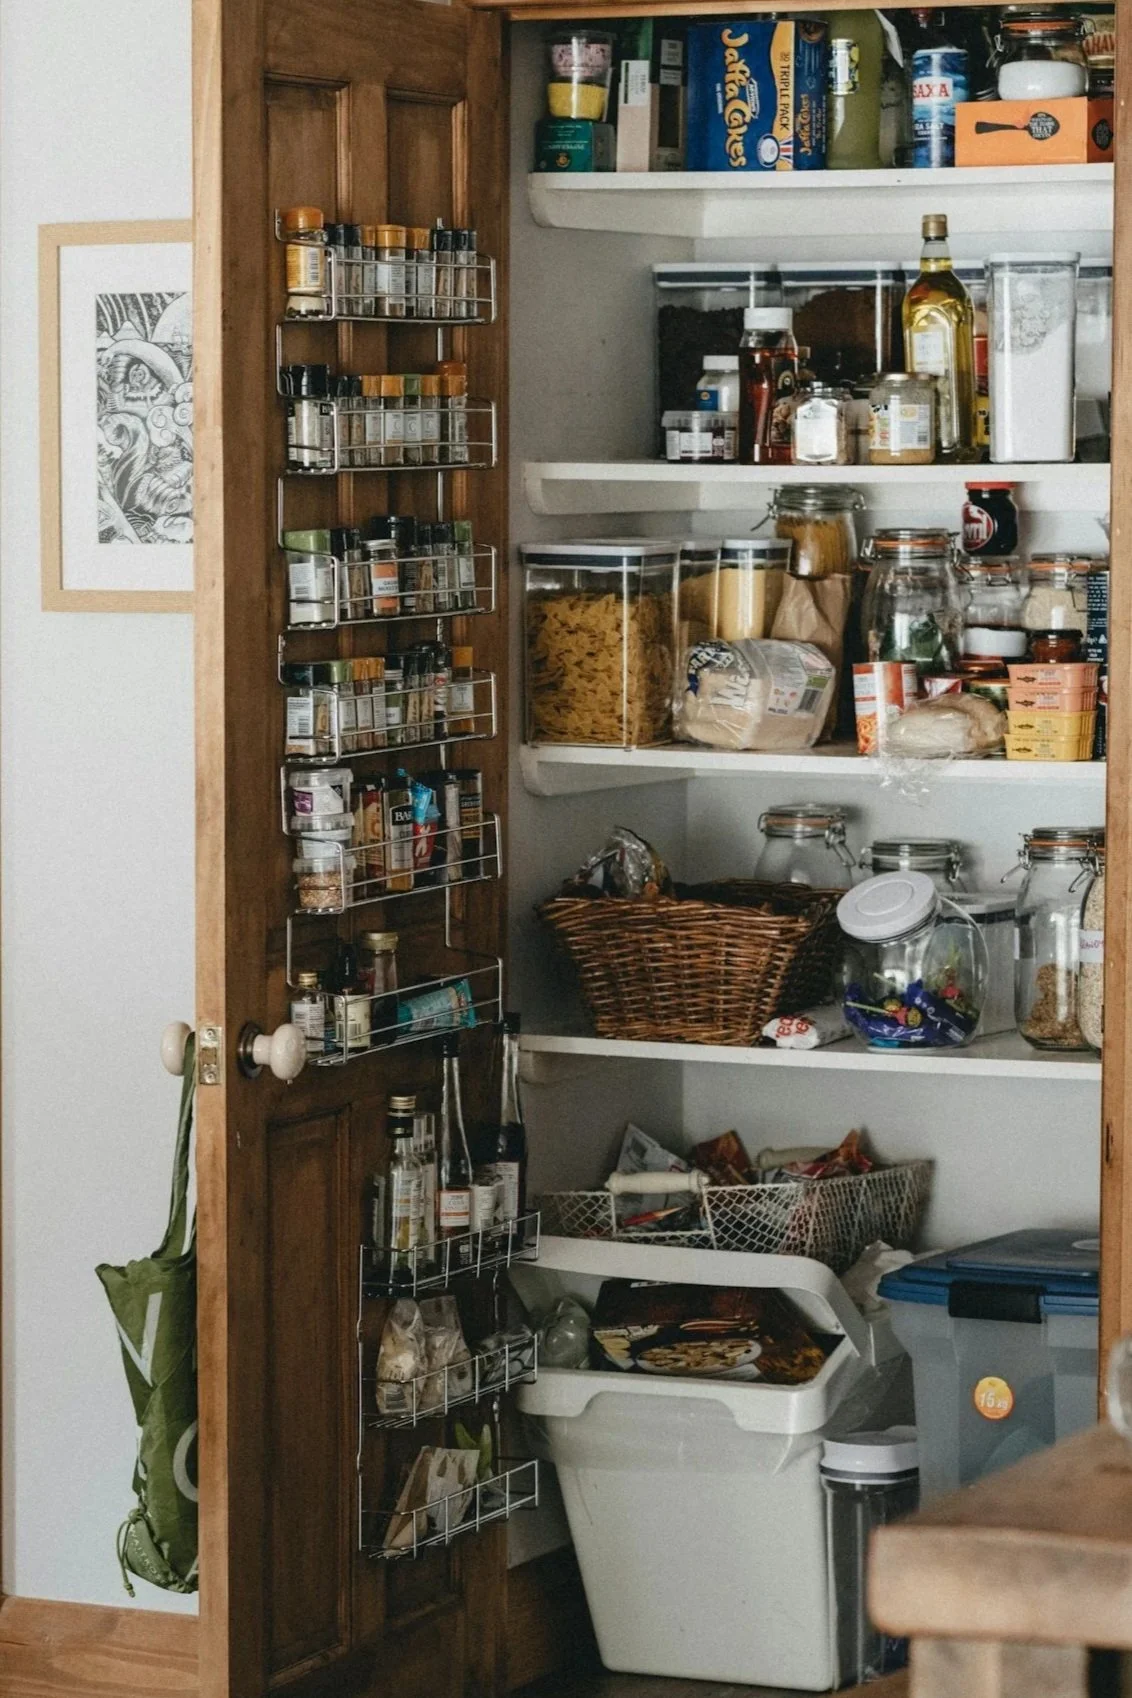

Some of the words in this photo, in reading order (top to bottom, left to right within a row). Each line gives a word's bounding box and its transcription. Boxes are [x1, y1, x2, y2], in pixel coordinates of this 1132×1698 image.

[720, 28, 750, 100] Jaffa
[779, 64, 791, 100] TRIPLE
[723, 98, 751, 169] Cakes
[779, 102, 791, 131] PACK
